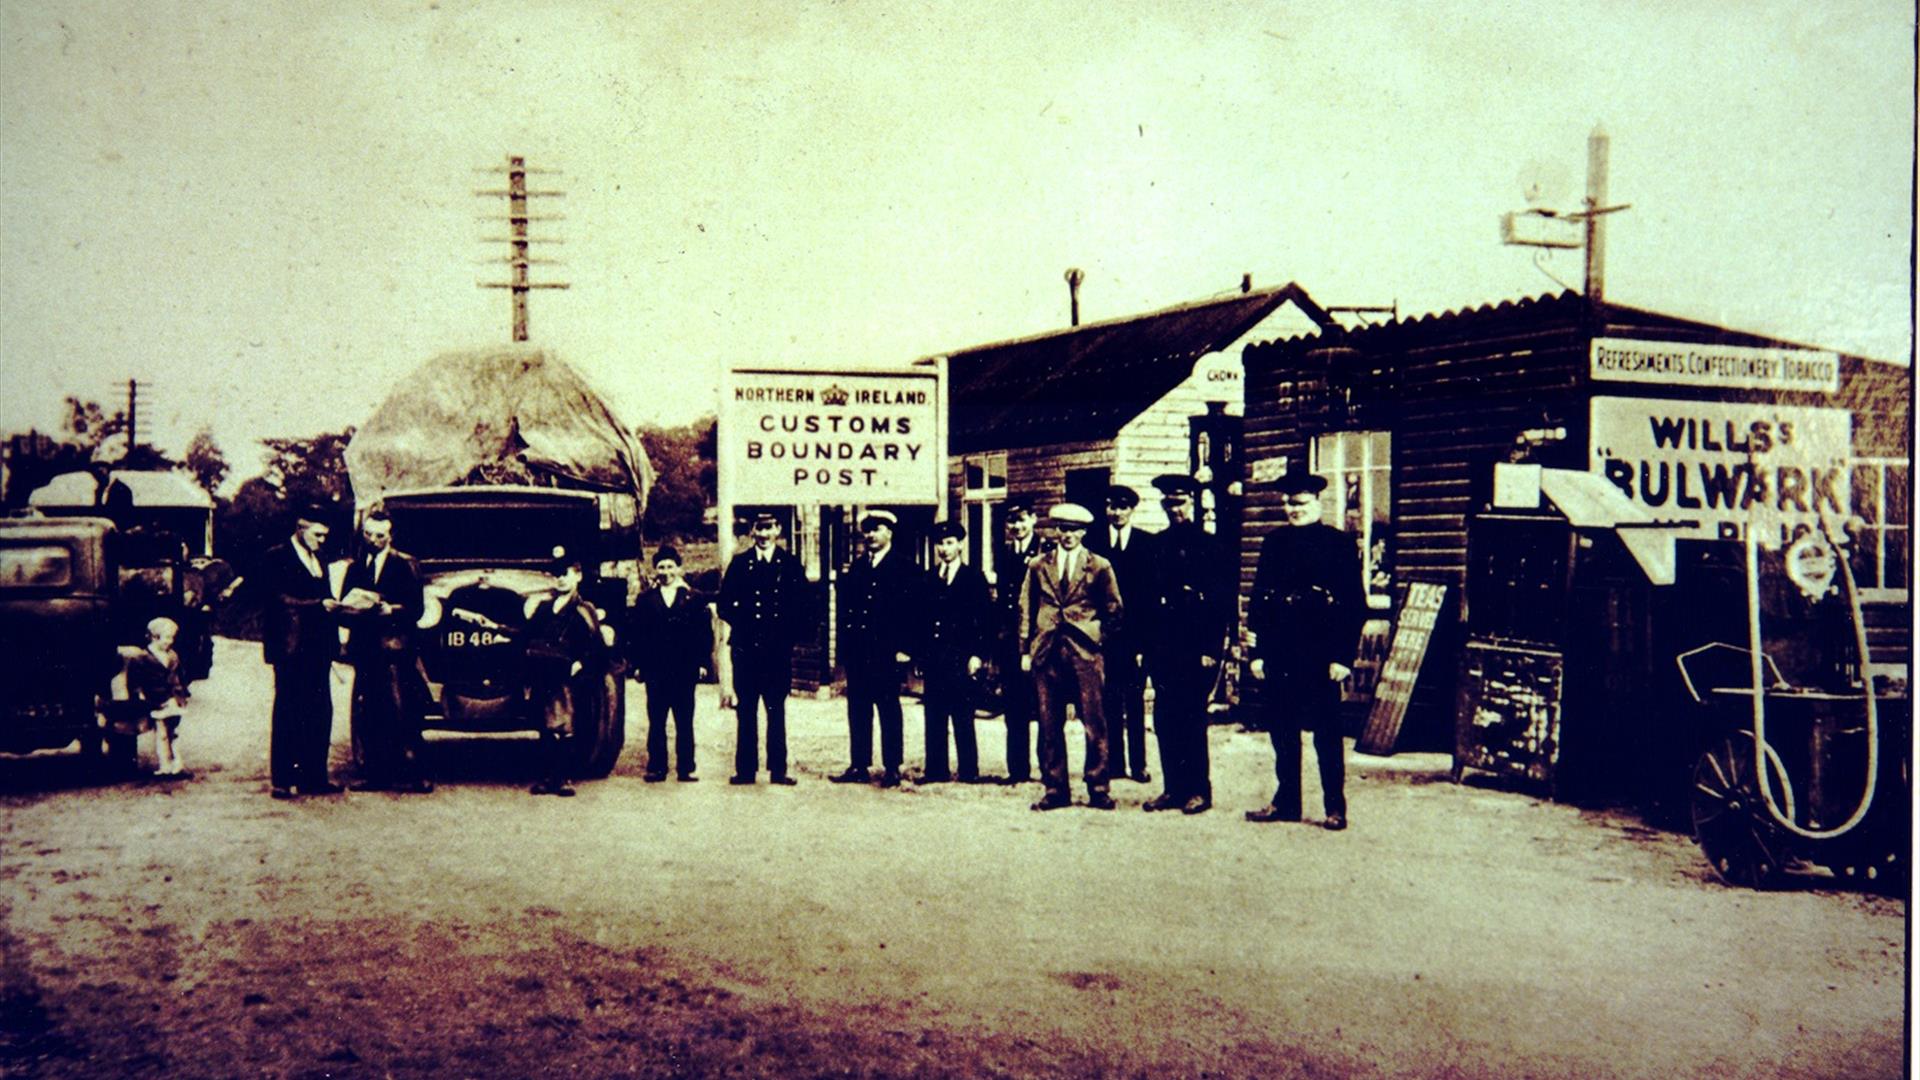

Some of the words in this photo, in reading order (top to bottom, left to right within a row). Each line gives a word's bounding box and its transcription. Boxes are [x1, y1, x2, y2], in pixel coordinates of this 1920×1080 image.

[735, 388, 815, 402] NORTHERN
[760, 415, 911, 434] CUSTOMS
[747, 442, 922, 461] BOUNDARY
[794, 469, 889, 486] POST.
[1408, 583, 1447, 609] TEAS
